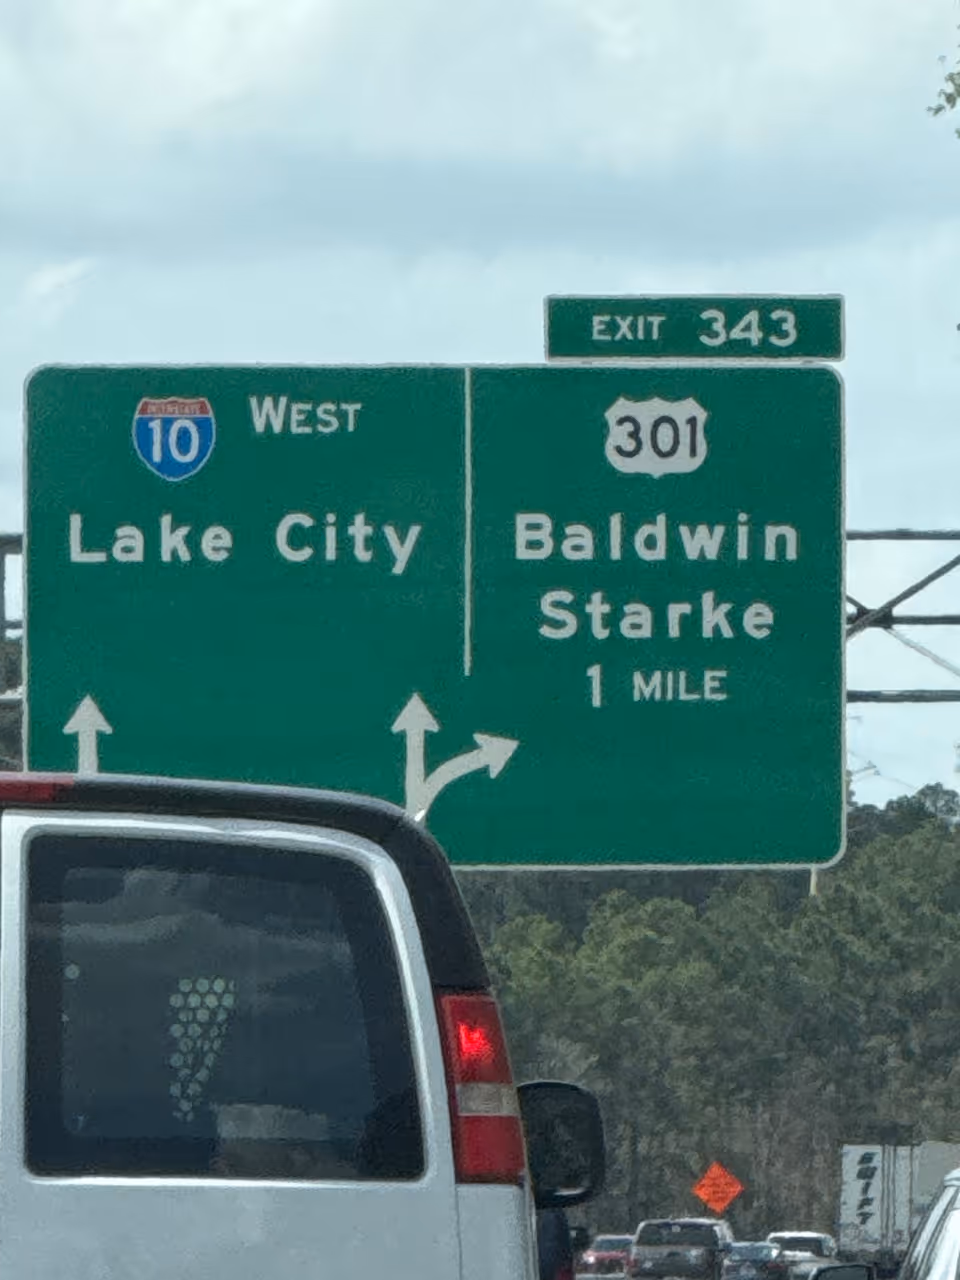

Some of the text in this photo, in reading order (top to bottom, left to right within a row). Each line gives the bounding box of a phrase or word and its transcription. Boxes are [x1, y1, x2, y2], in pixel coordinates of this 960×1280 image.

[591, 308, 798, 347] EXIT 343
[147, 418, 200, 464] 10
[613, 414, 699, 459] 301
[68, 511, 422, 575] Lake City
[514, 511, 798, 562] Baldwin
[539, 589, 775, 640] Starke
[586, 663, 728, 708] 1 MILE
